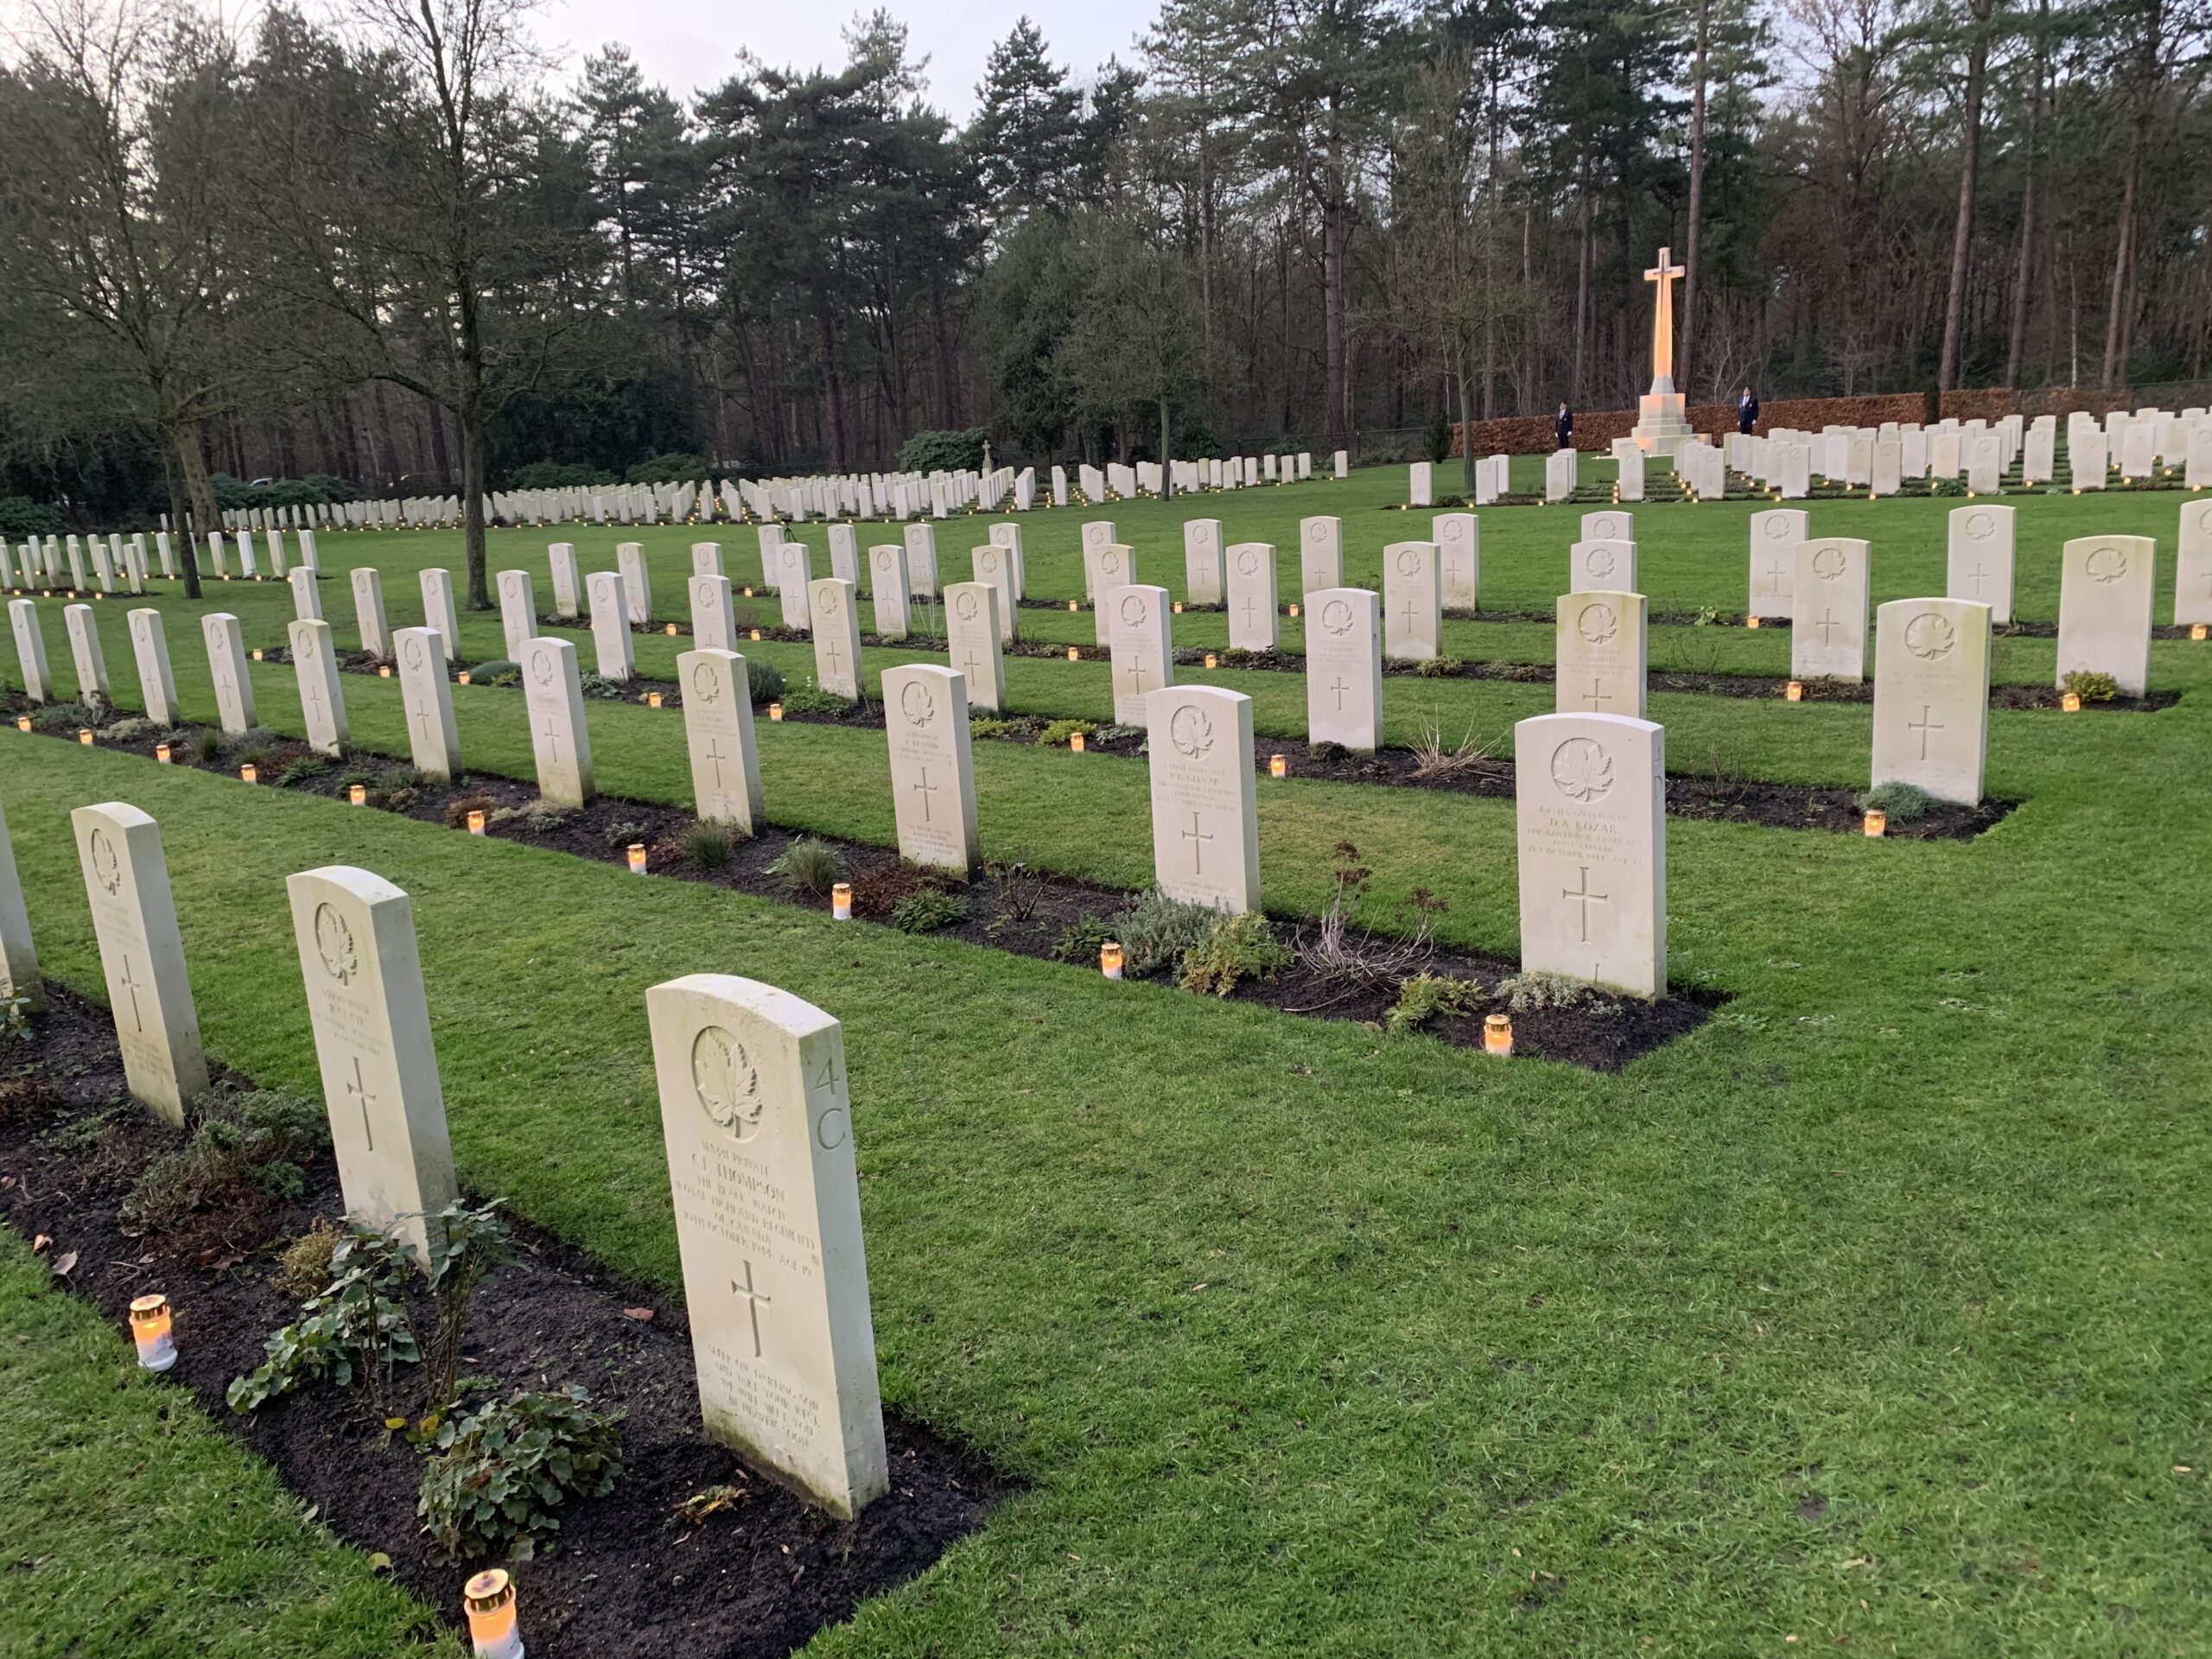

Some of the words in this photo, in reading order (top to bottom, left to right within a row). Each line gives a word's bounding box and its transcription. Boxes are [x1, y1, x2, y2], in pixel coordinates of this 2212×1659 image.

[1654, 775, 1662, 799] D
[812, 1057, 839, 1096] 4
[817, 1109, 846, 1150] C
[696, 1175, 712, 1190] THE
[717, 1183, 745, 1203] BLACK
[753, 1198, 787, 1222] WATCH
[715, 1162, 786, 1203] THOMPSON
[711, 1195, 759, 1225] HIGHLAND
[730, 1219, 772, 1247] CANADA
